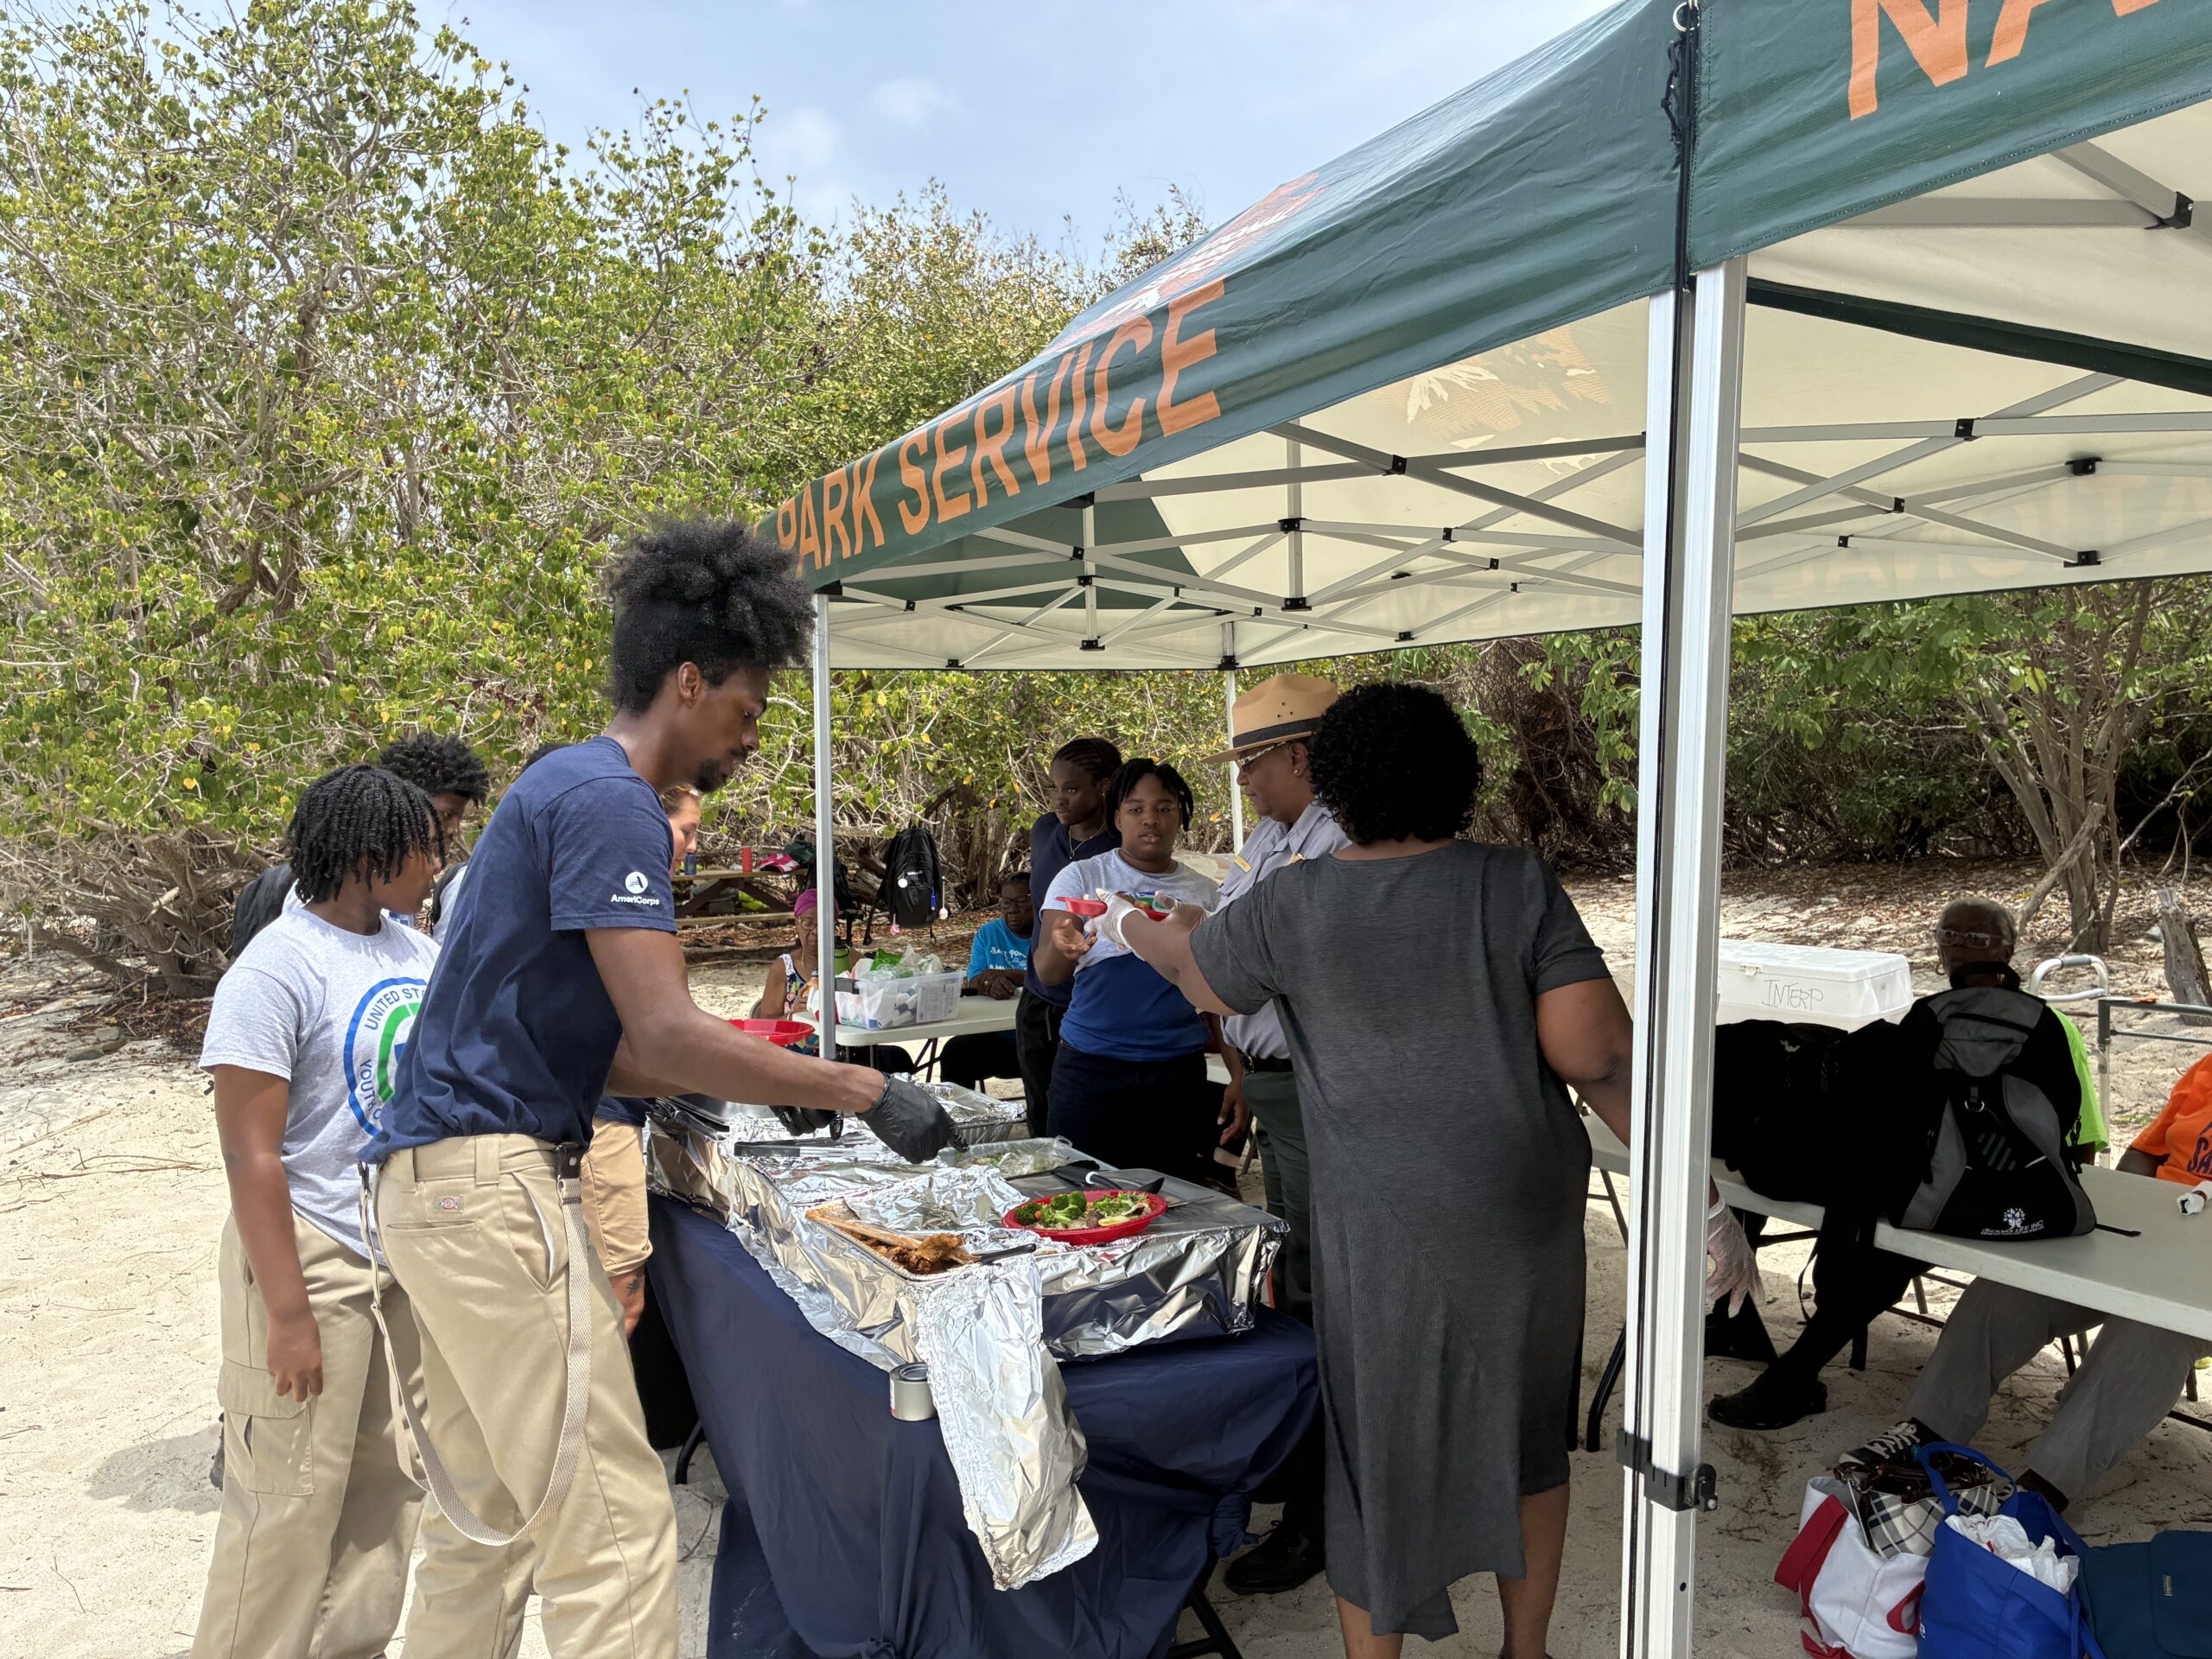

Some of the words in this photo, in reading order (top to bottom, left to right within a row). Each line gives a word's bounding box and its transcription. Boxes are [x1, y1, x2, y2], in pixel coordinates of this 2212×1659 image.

[777, 448, 884, 581] PARK
[898, 274, 1226, 536] SERVICE
[610, 893, 660, 906] AmeriCorps
[365, 990, 400, 1031] UNITED
[402, 988, 425, 999] ST
[1761, 979, 1824, 1011] INTERP
[2187, 1136, 2212, 1175] SA
[2031, 1219, 2044, 1230] INC
